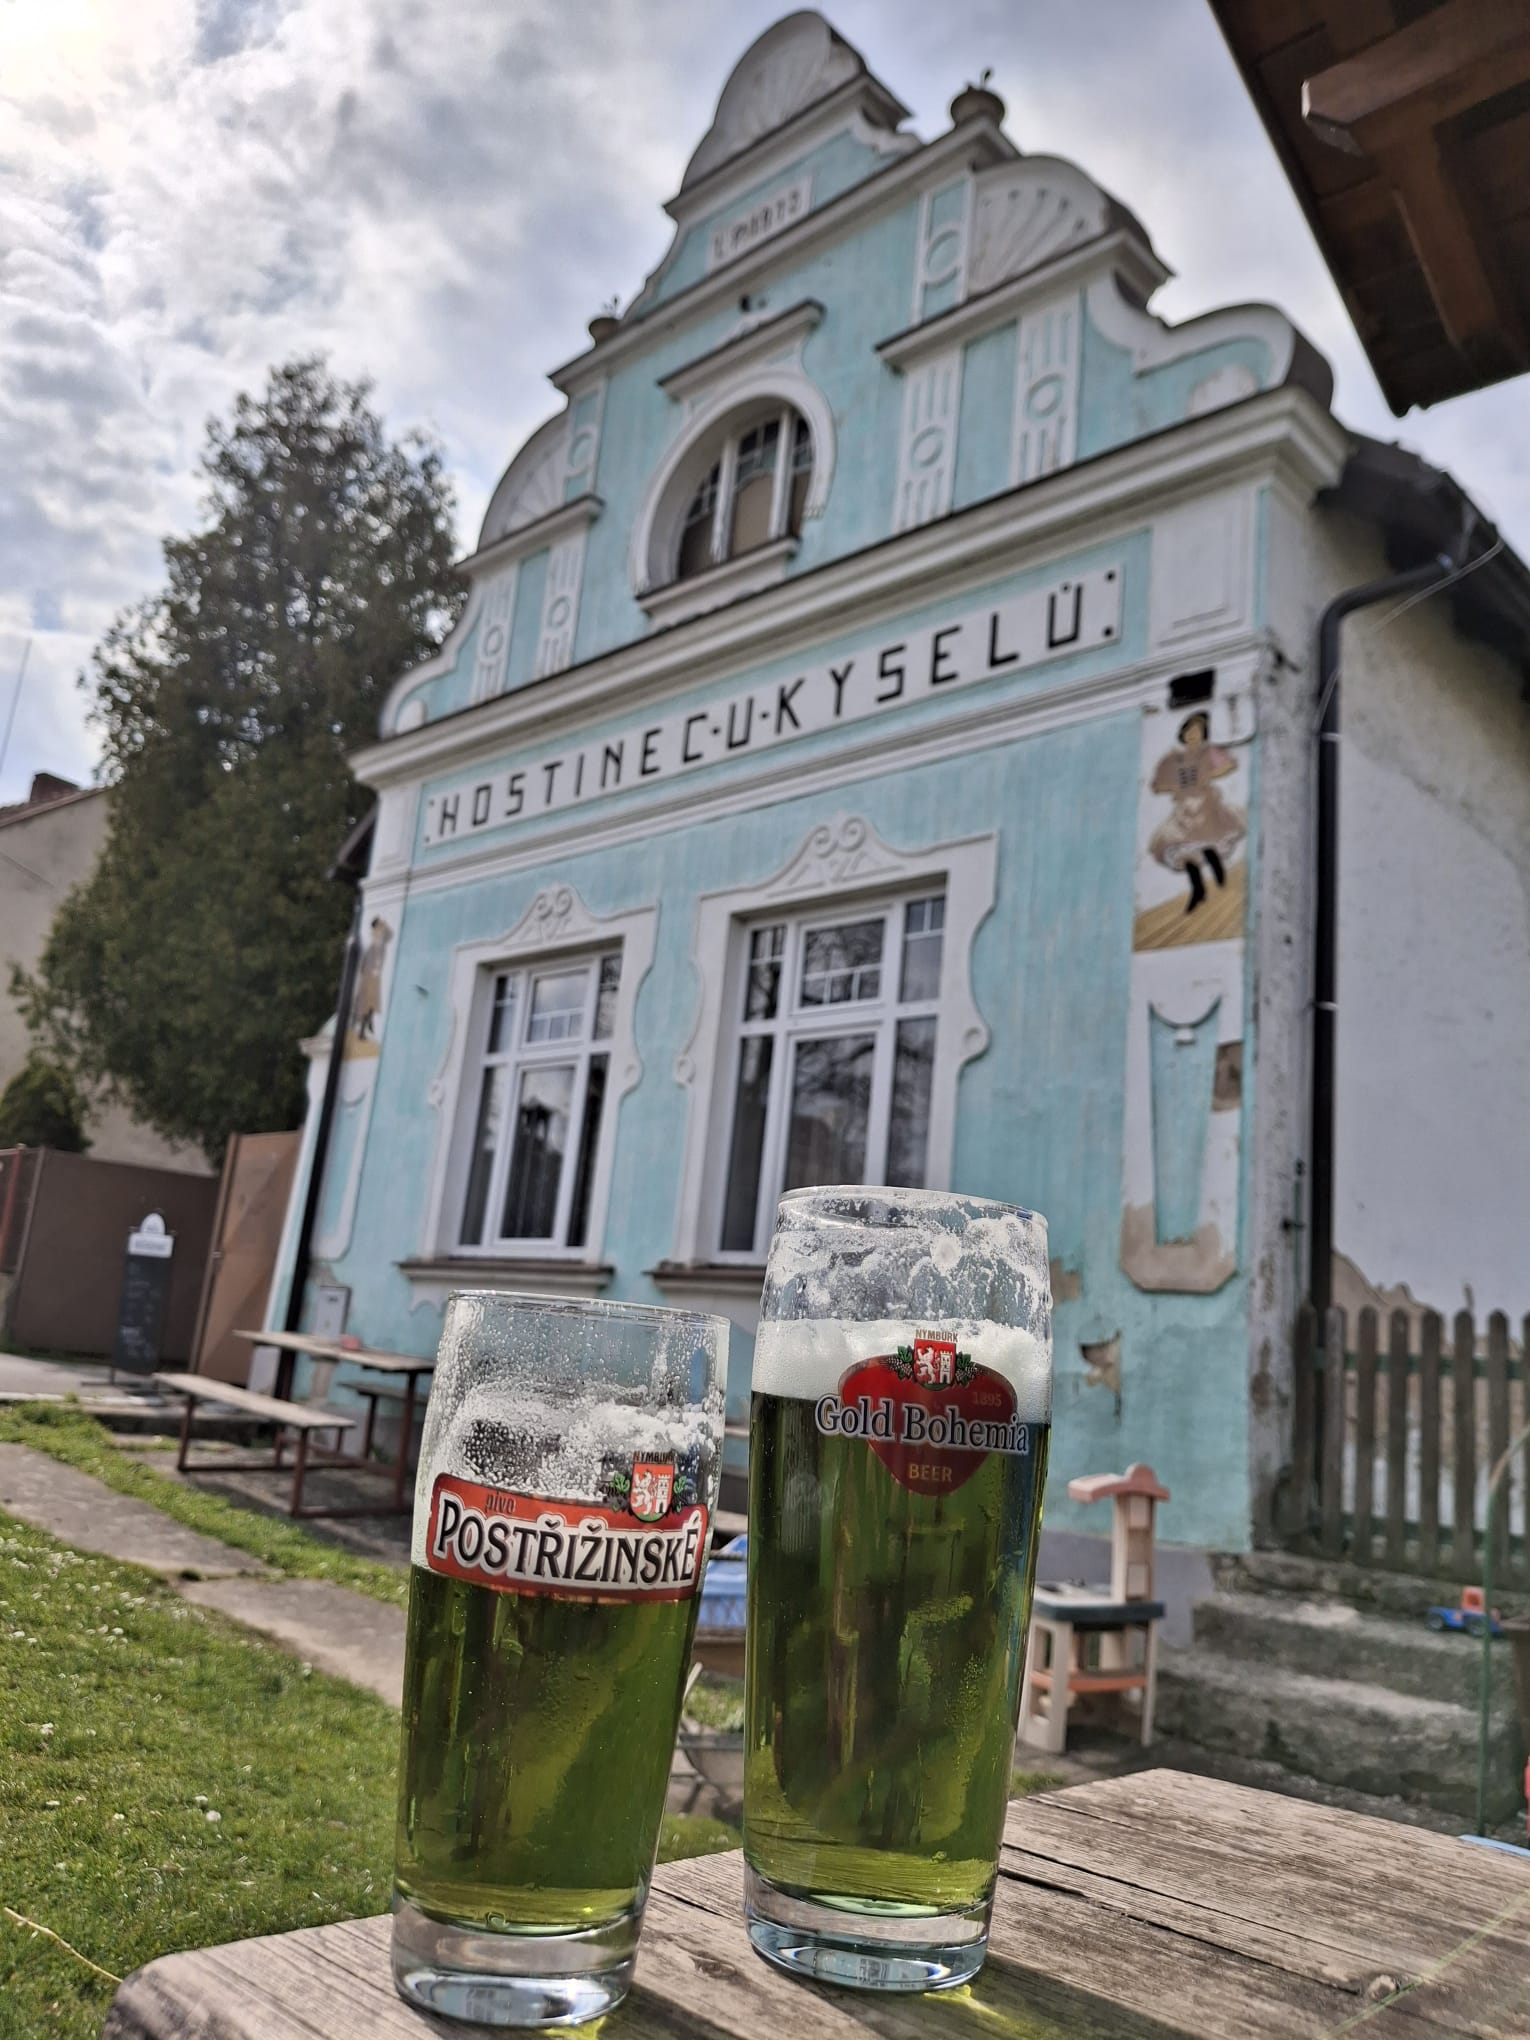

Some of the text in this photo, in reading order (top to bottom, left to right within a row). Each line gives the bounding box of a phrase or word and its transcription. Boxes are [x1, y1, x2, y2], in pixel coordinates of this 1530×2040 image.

[915, 1329, 959, 1343] NYMBURK
[971, 1391, 1003, 1408] 1895
[816, 1395, 1030, 1453] Gold Bohemia
[908, 1463, 953, 1483] BEER
[485, 1490, 517, 1515] pivo
[437, 1498, 701, 1584] POSTŘIŽINSKÉ
